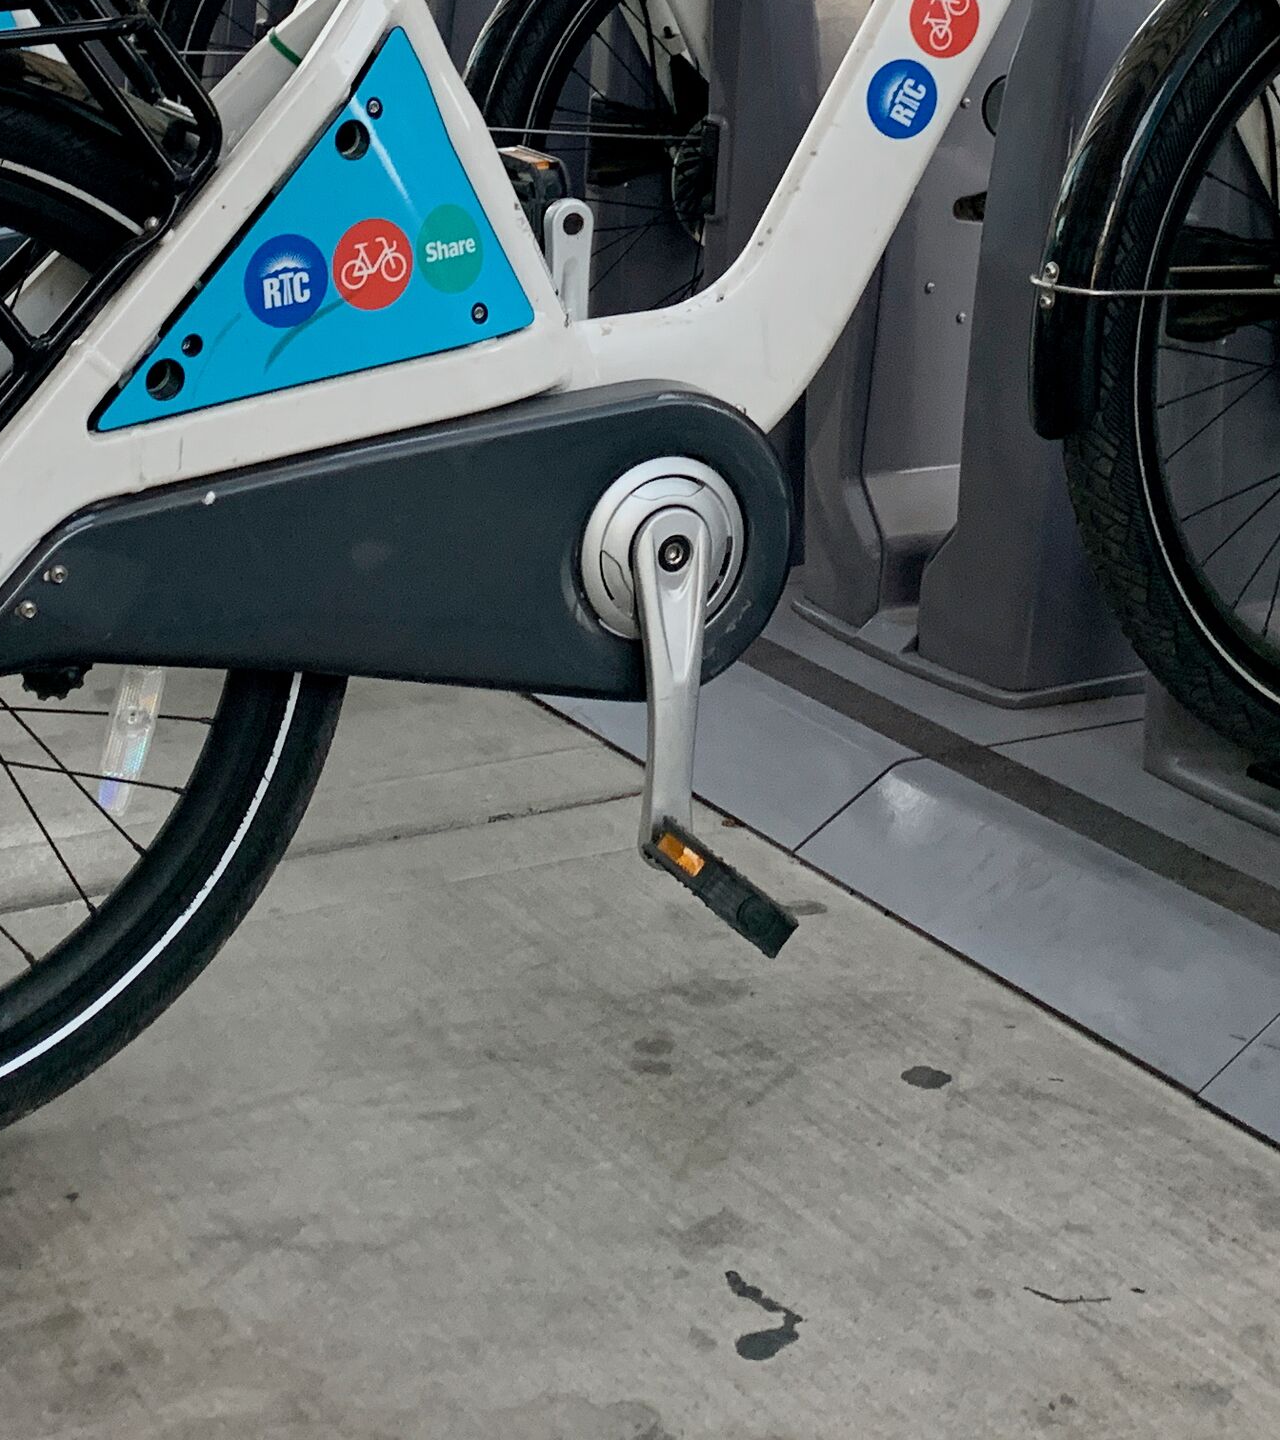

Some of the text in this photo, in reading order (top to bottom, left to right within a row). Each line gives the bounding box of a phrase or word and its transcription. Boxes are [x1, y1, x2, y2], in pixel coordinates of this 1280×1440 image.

[889, 78, 927, 128] RTC
[262, 237, 476, 310] RTC Share
